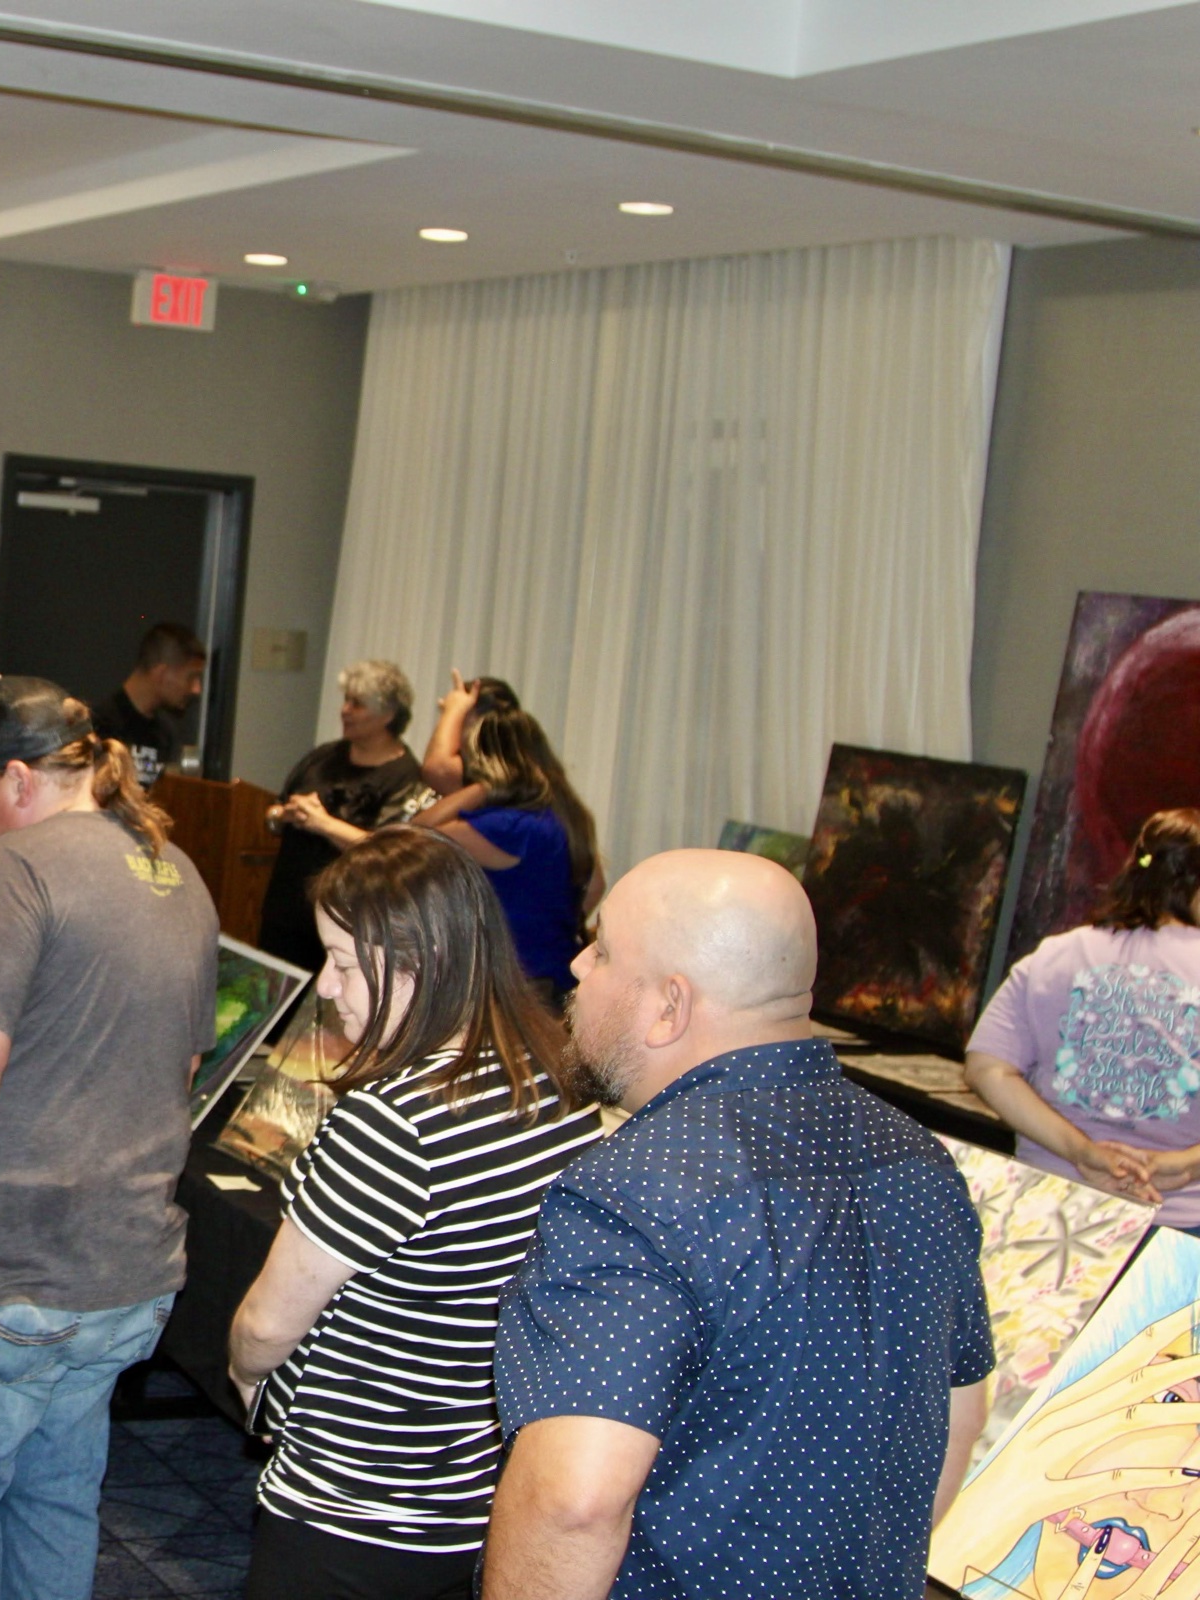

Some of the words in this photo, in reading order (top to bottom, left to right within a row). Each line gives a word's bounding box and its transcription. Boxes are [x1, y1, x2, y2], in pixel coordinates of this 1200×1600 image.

[150, 273, 209, 327] EXIT
[1096, 973, 1135, 1000] She
[1097, 1011, 1132, 1037] She
[1080, 1025, 1175, 1066] fearless
[1088, 1054, 1128, 1078] She
[1081, 1073, 1165, 1110] enough
